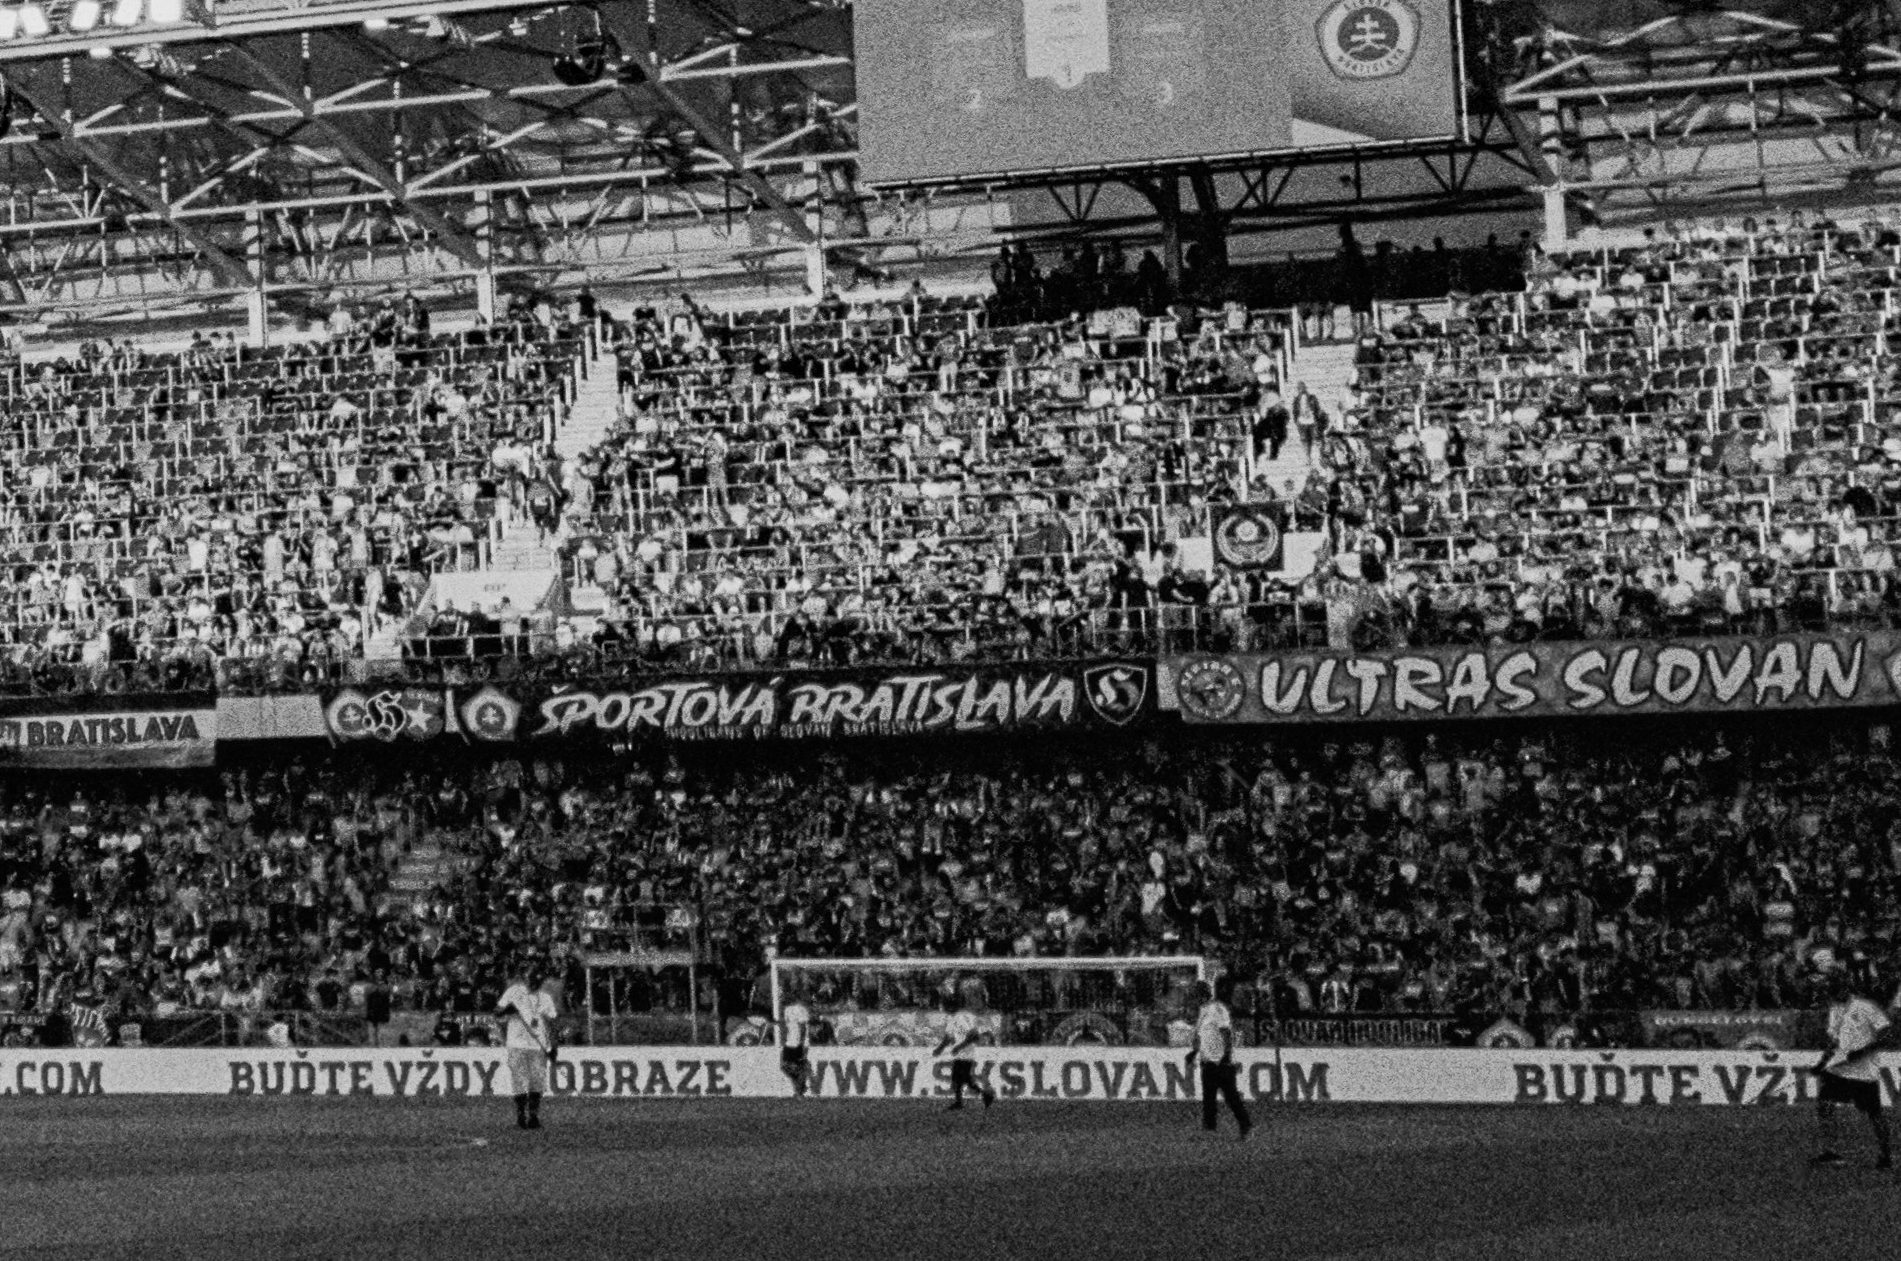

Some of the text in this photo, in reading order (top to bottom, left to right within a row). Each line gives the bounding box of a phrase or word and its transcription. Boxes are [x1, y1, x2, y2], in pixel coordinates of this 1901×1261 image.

[1261, 650, 1537, 716] ULTRAS
[1564, 639, 1863, 711] SLOVAN
[27, 714, 201, 746] BRATISLAVA
[531, 674, 1075, 736] ŠPORTOVÁ BRATISLAVA
[228, 1049, 733, 1096] BUĎTE VŽDY OBRAZE
[1513, 1052, 1702, 1105] BUĎTE
